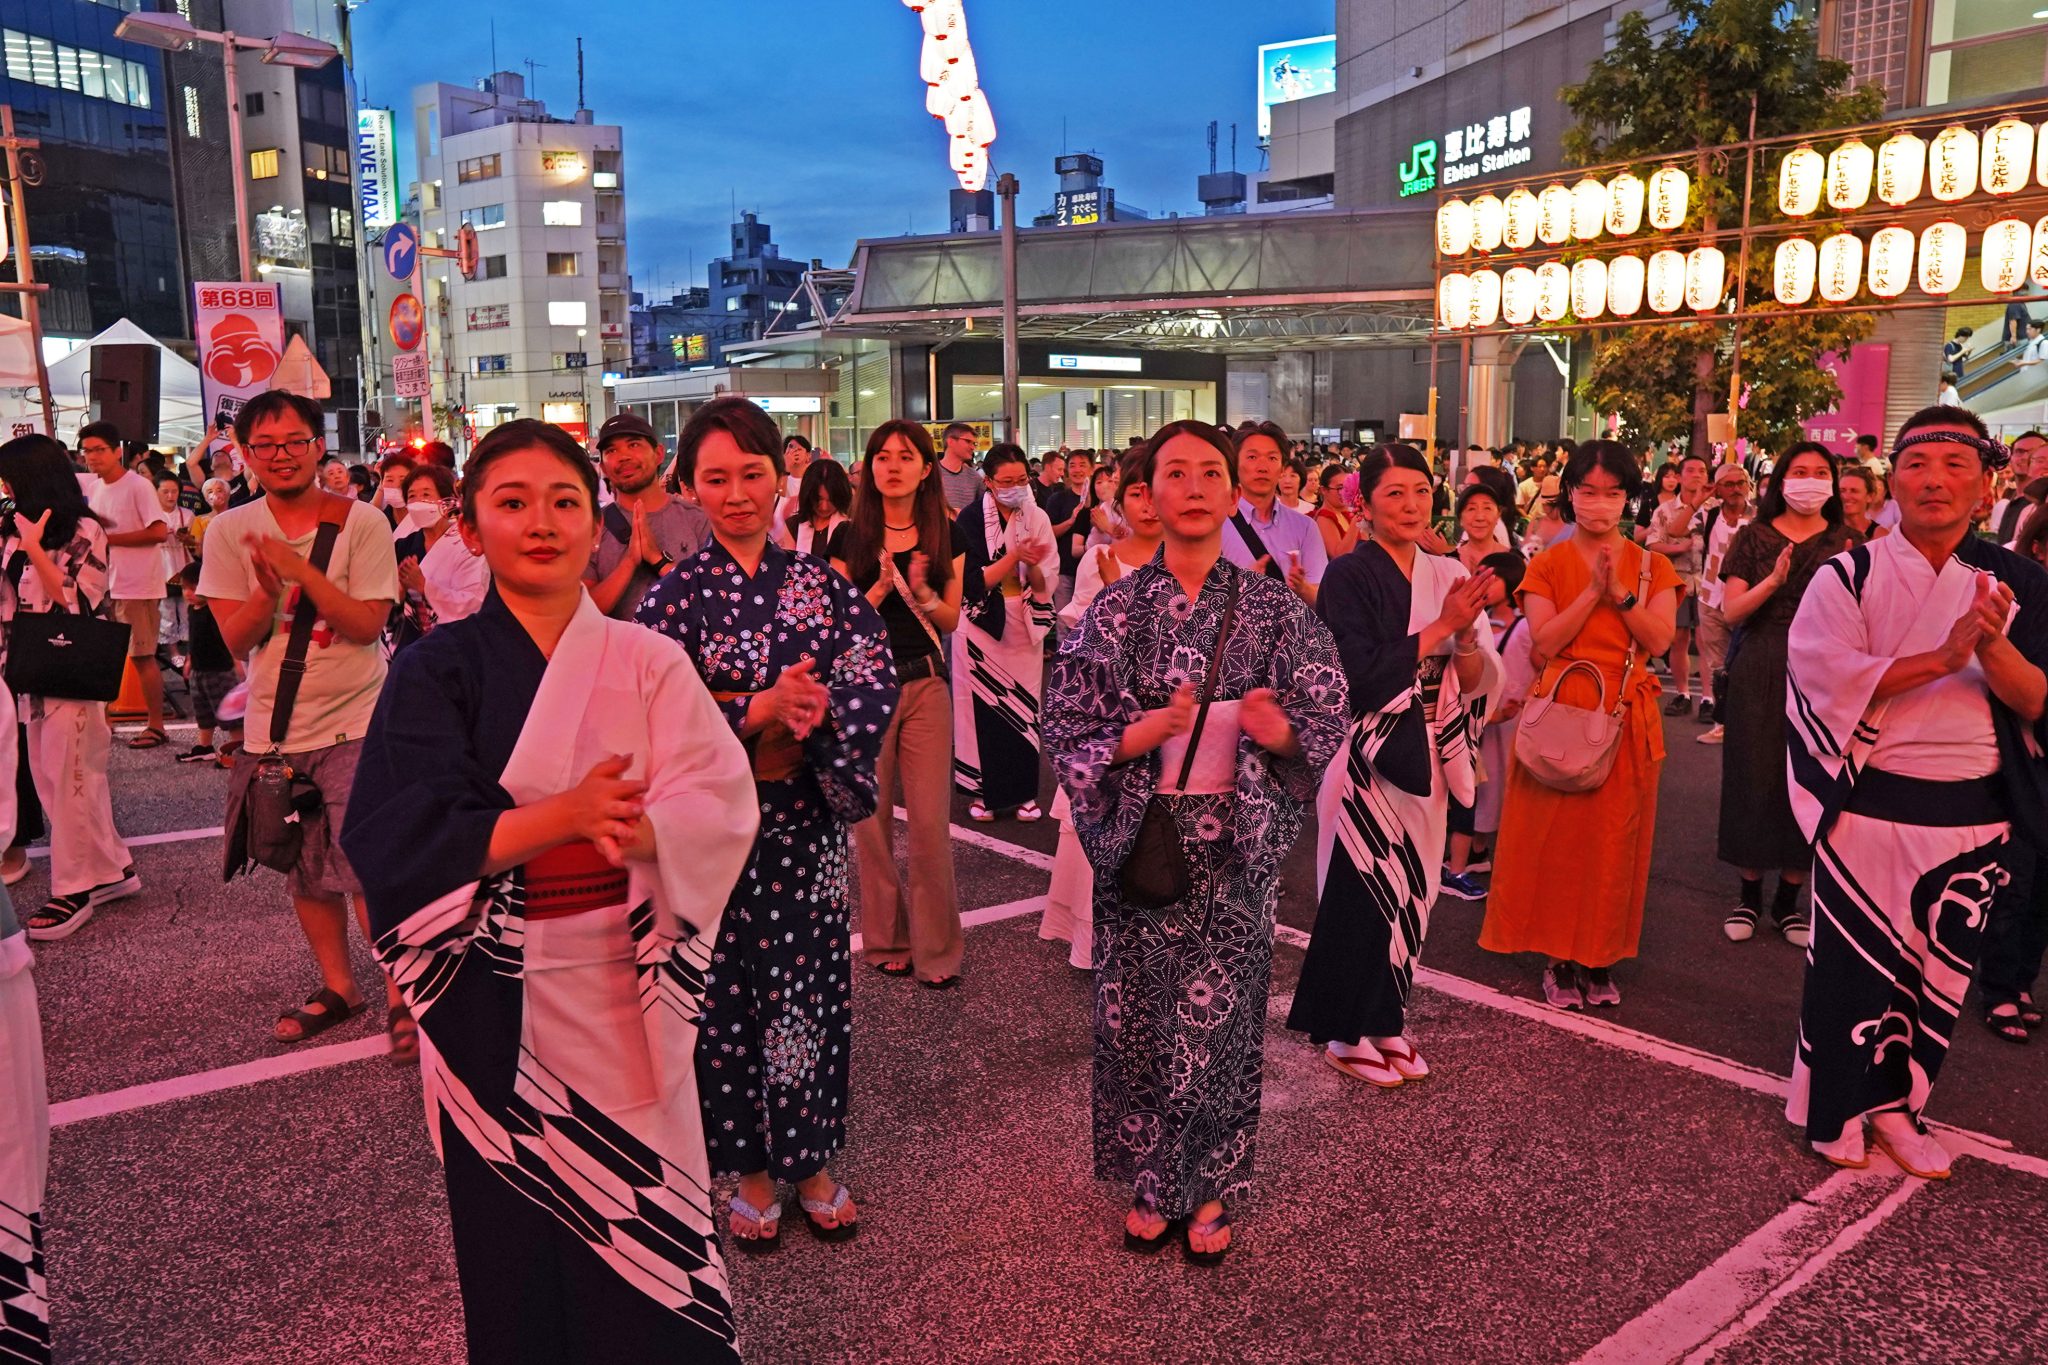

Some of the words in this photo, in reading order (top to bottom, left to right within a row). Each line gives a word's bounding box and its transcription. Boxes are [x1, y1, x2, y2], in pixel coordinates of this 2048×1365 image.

[1445, 106, 1531, 163] 恵比寿駅
[1400, 140, 1437, 183] JR
[1443, 162, 1479, 184] Ebisu
[1481, 146, 1531, 173] Station
[1990, 124, 2014, 188] アトレ恵比寿
[361, 179, 380, 223] MAX
[200, 289, 274, 308] 第68回
[397, 381, 427, 395] ここまで
[1810, 428, 1837, 442] 西館
